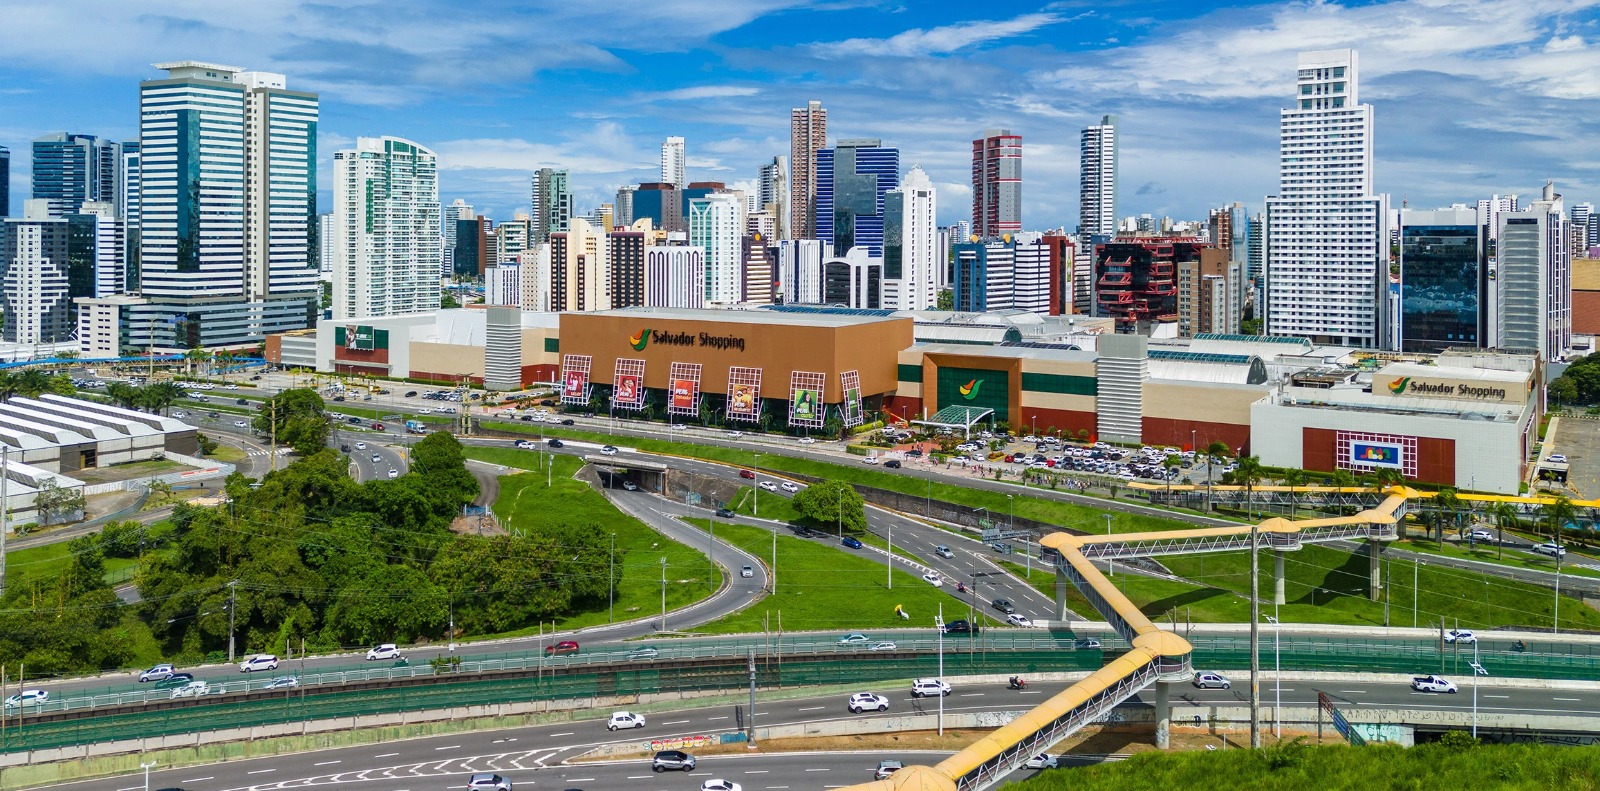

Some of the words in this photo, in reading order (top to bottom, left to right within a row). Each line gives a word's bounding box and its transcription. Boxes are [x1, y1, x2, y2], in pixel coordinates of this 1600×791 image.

[653, 330, 696, 345] Salvador
[699, 332, 745, 352] Shopping
[1410, 381, 1455, 394] Salvador
[1458, 384, 1506, 400] Shopping
